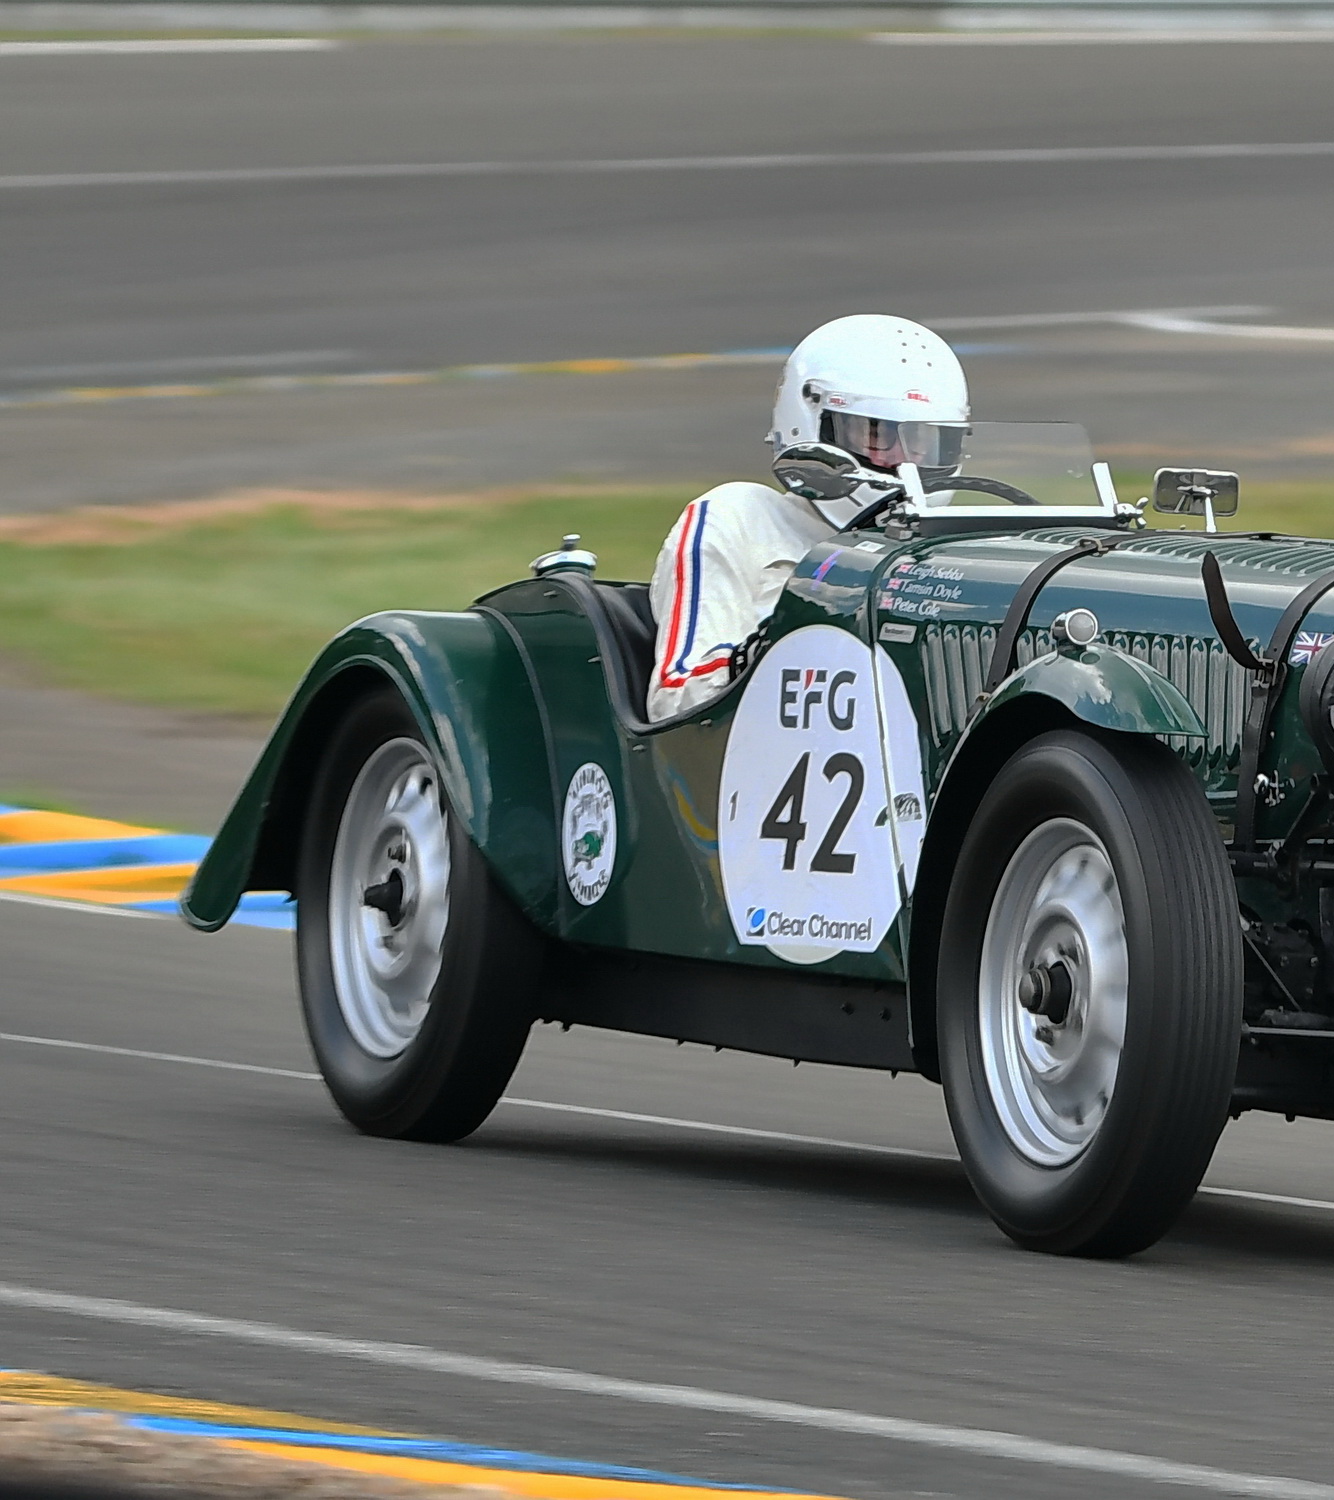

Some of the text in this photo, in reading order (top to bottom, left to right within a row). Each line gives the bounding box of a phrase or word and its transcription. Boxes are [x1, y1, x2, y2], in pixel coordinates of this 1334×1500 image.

[908, 565, 936, 580] Leigh
[901, 579, 963, 601] Tamsin Doyle
[893, 597, 941, 617] Peter Cole
[779, 669, 857, 731] EFG
[759, 751, 866, 875] 42
[767, 913, 872, 941] Clear Channel
